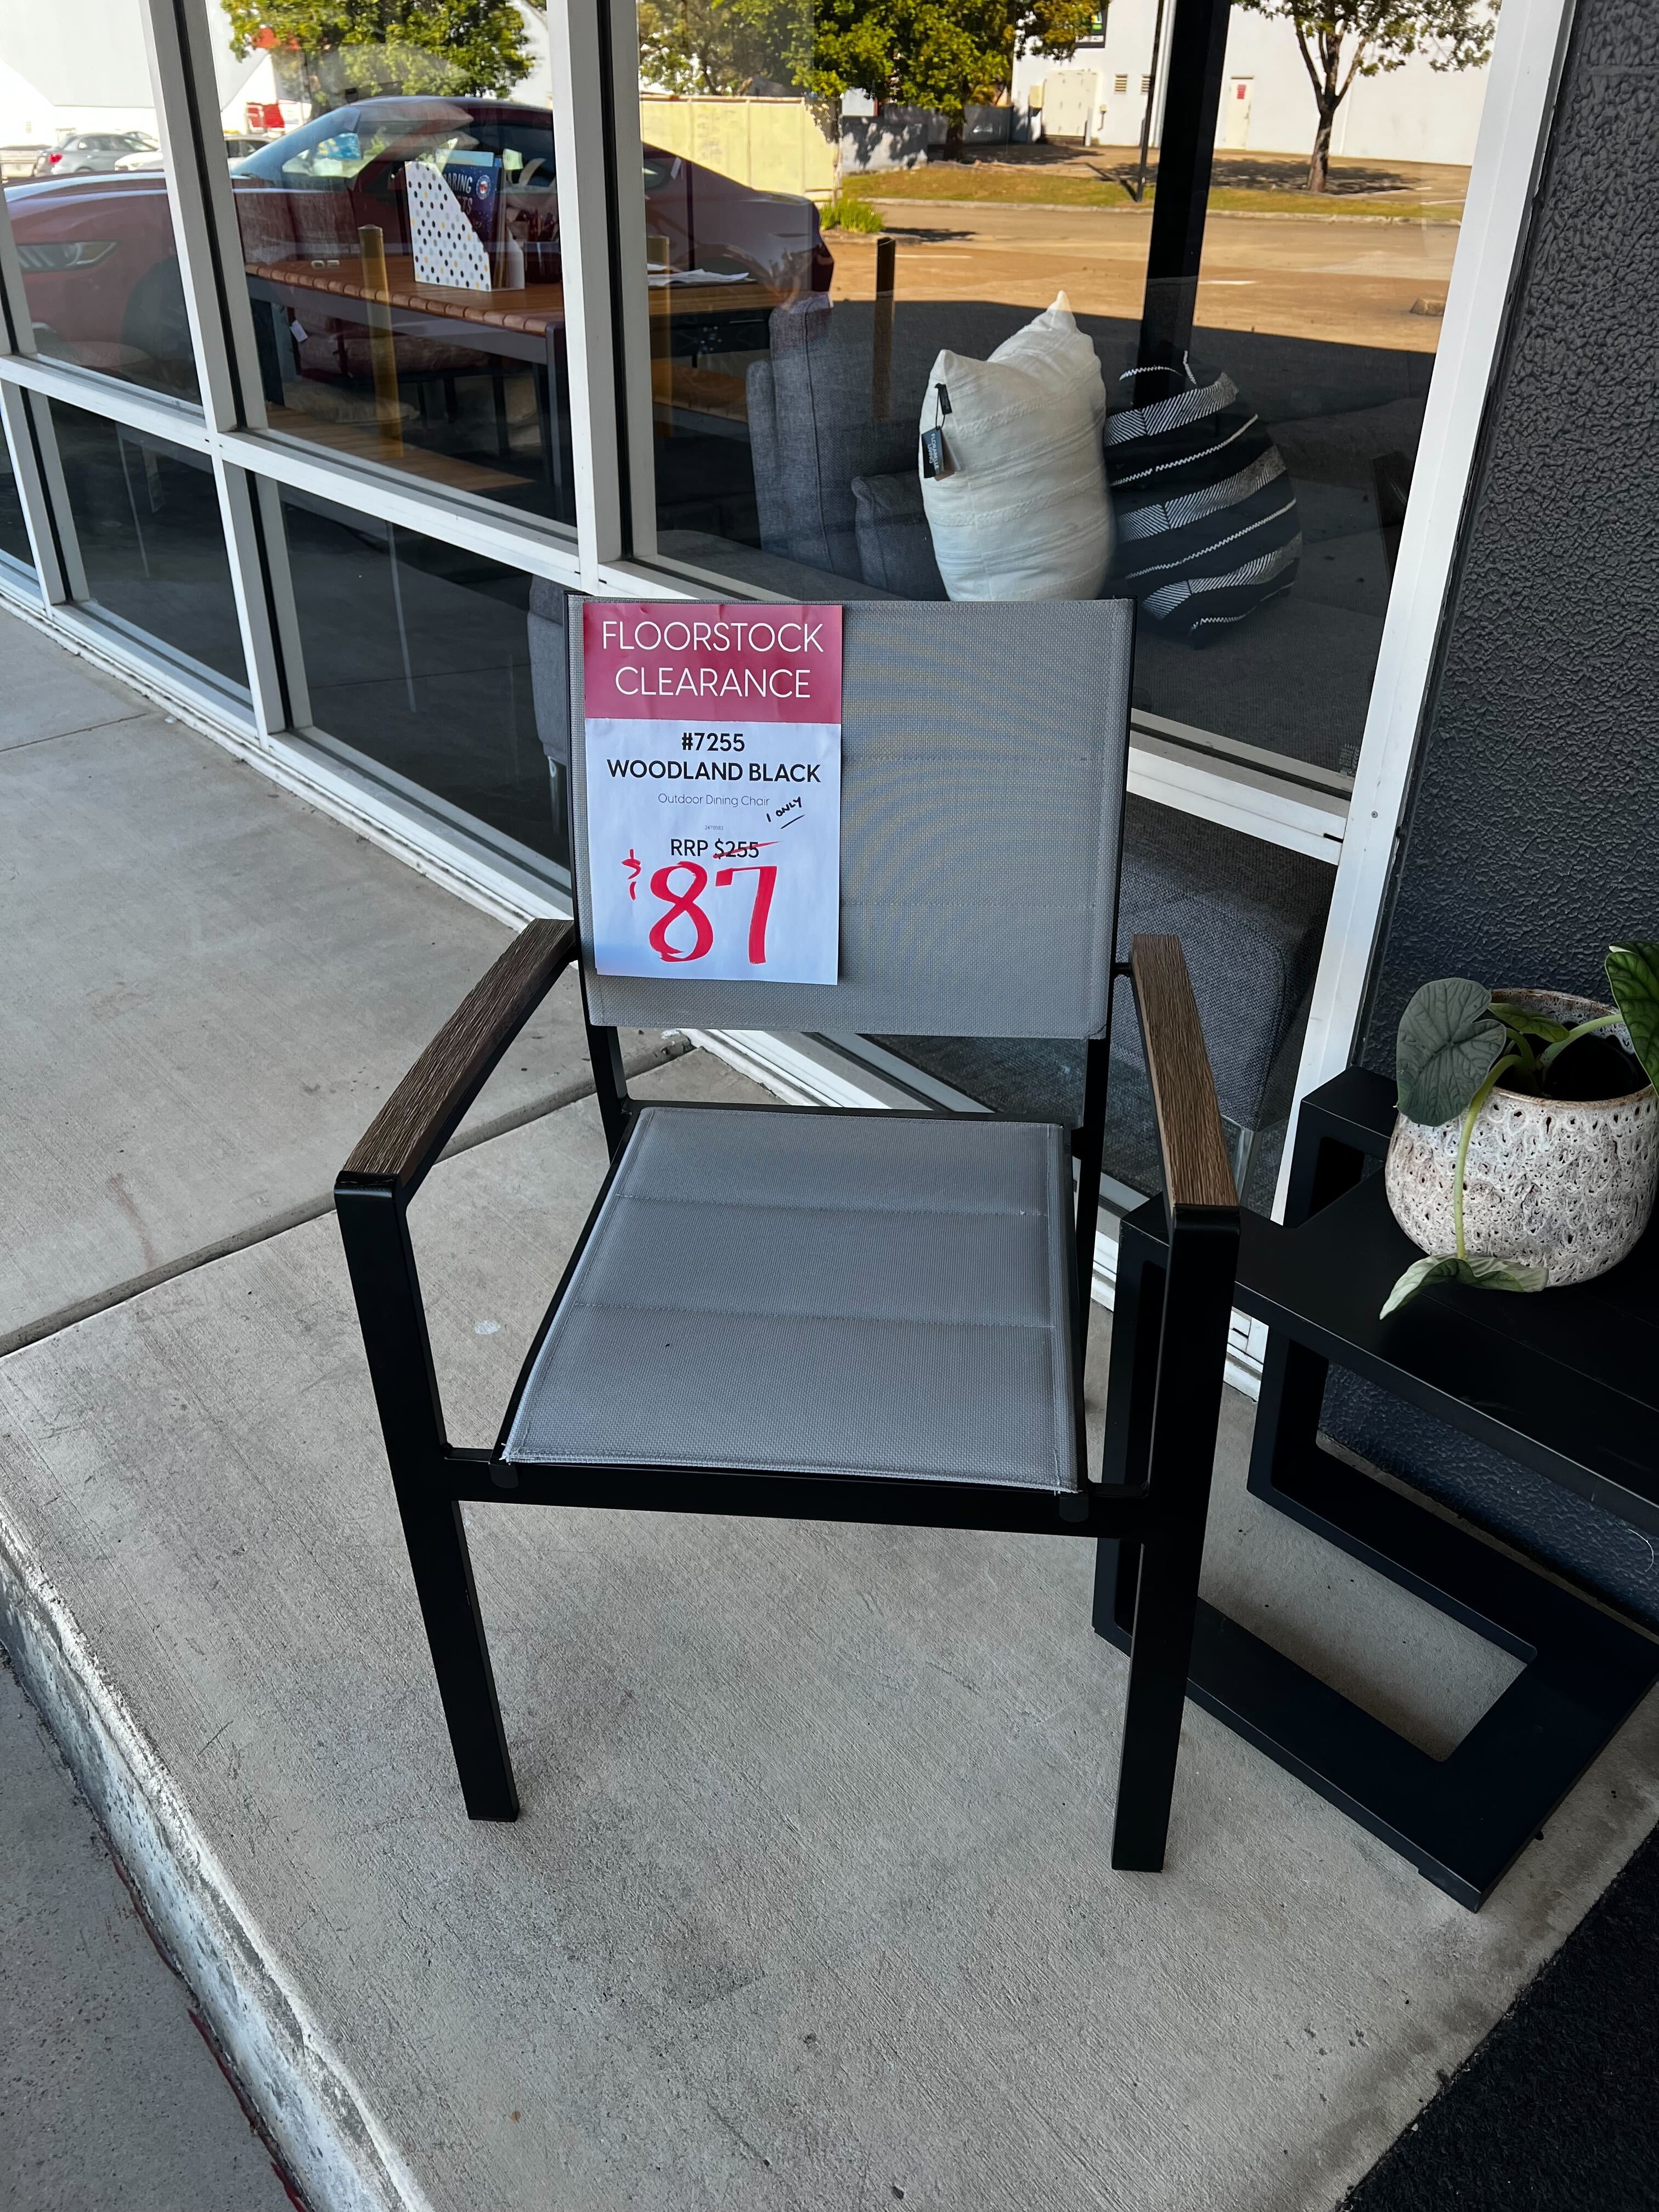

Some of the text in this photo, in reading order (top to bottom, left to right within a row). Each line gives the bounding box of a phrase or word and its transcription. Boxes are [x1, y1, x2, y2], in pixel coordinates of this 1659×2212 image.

[603, 621, 824, 652] FLOORSTOCK
[615, 667, 811, 698] CLEARANCE
[681, 732, 746, 752] #7255
[606, 759, 821, 783] WOODLAND BLACK
[658, 793, 770, 808] Outdoor Dining Chair
[775, 796, 802, 817] ONLY
[670, 838, 759, 859] RRP $255
